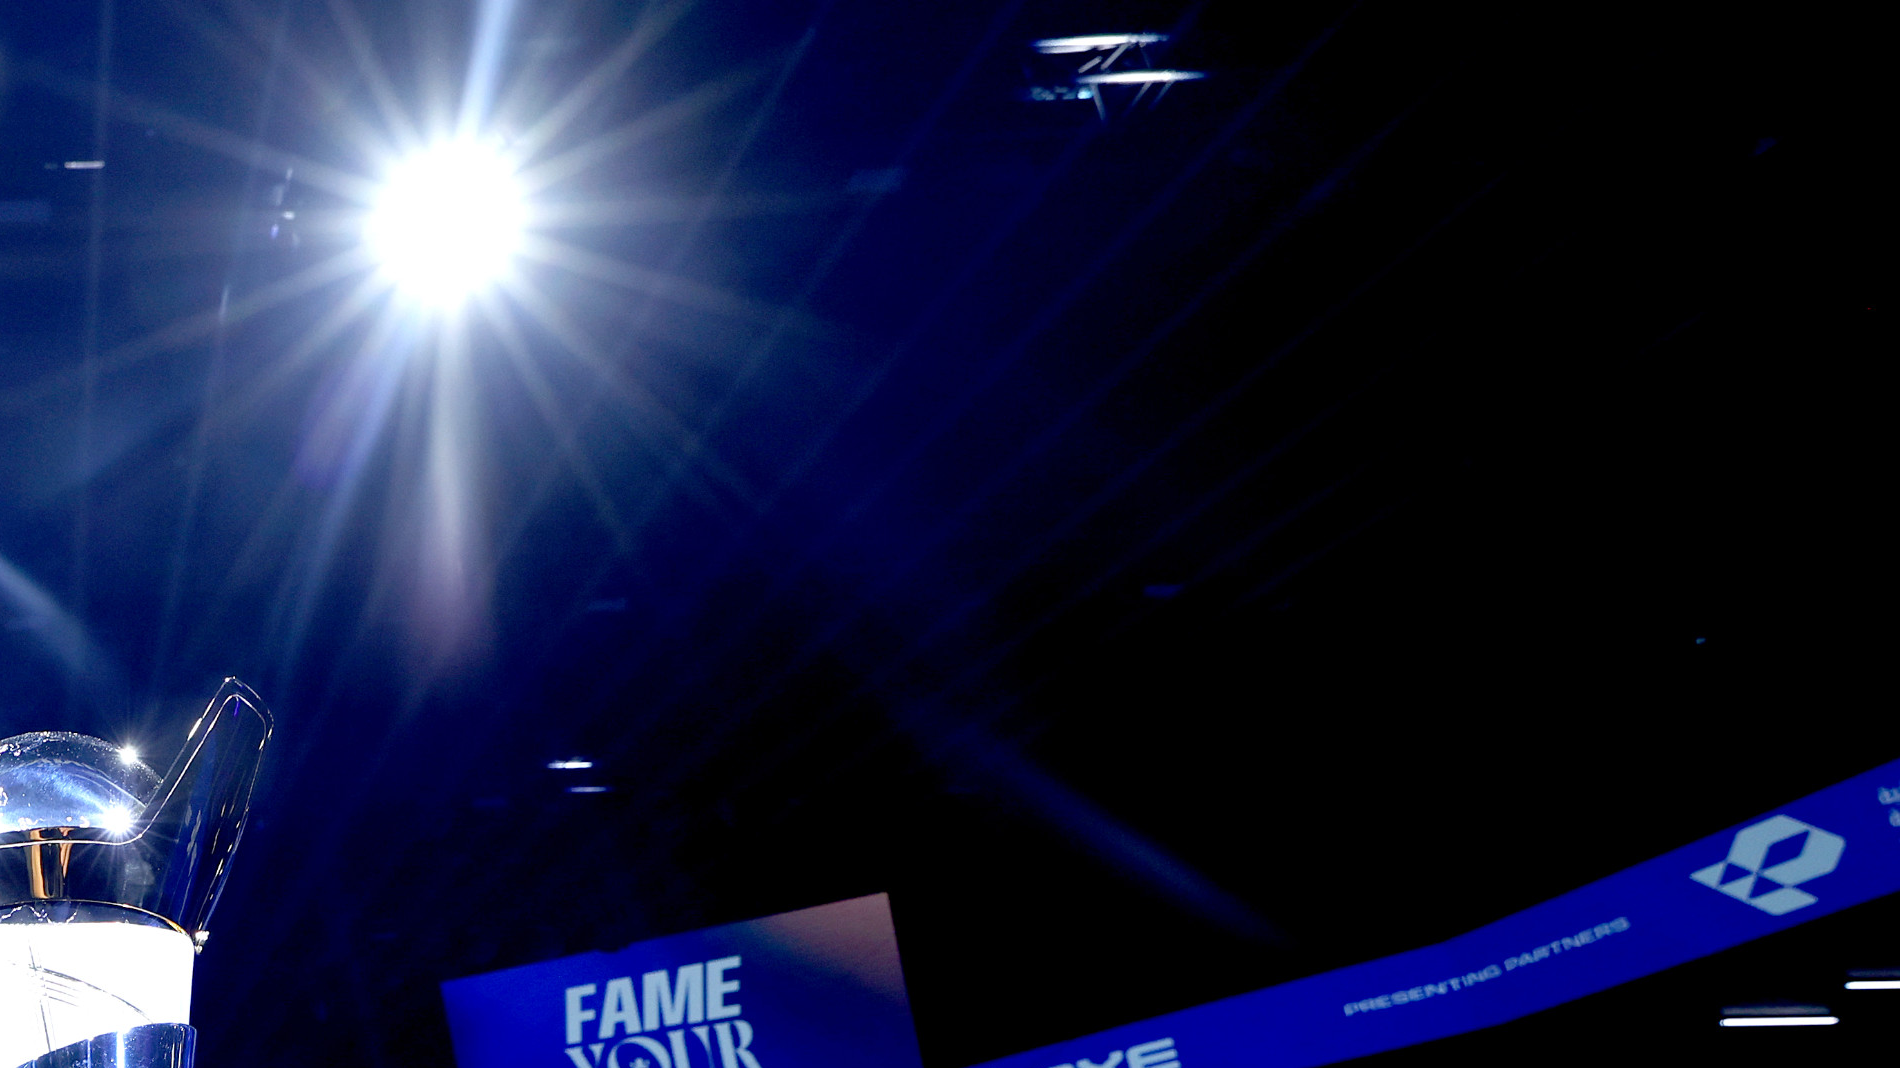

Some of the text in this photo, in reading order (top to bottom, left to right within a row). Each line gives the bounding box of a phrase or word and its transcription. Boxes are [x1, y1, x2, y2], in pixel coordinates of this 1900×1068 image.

[564, 954, 742, 1045] FAME
[1343, 916, 1630, 1017] PRESENTING PARTNERS
